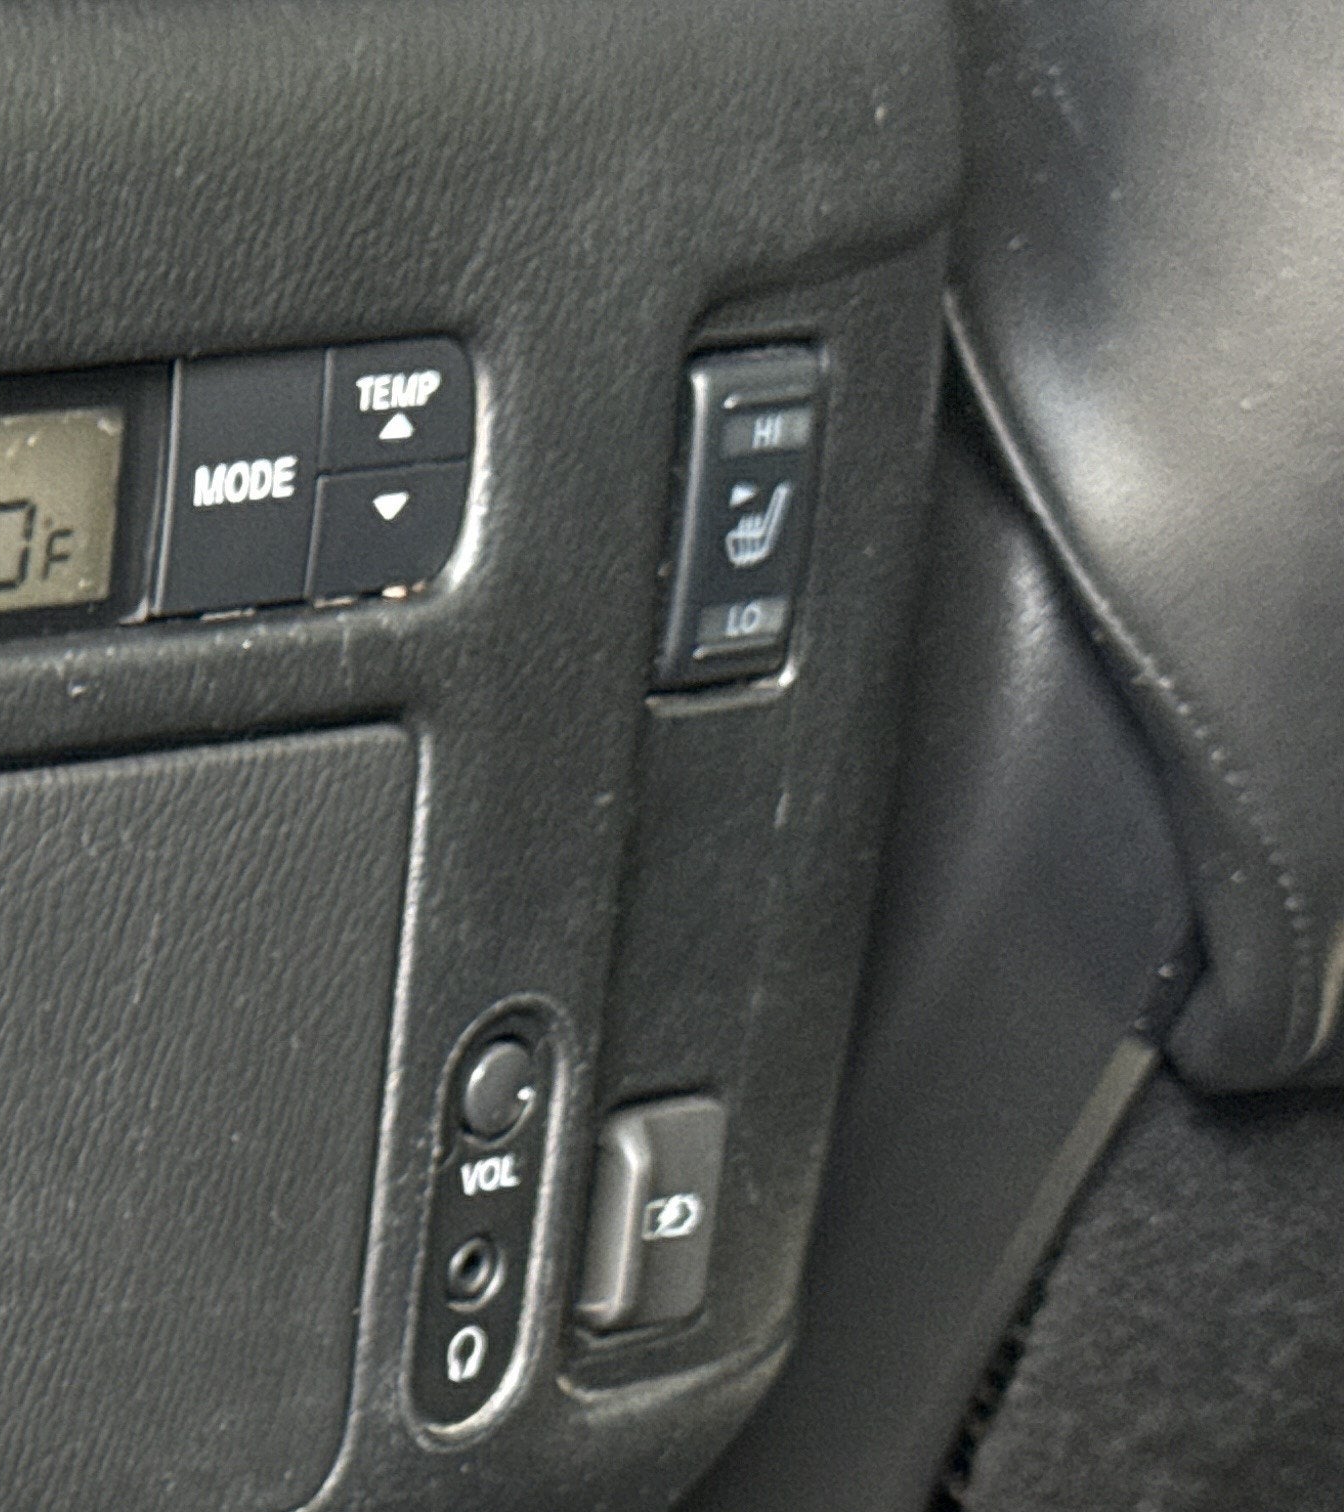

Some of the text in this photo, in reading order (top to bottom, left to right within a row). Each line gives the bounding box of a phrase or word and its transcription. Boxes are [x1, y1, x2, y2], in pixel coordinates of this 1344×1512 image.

[356, 370, 440, 411] TEMP
[752, 413, 782, 449] HI
[193, 455, 297, 506] MODE
[725, 603, 762, 637] LO
[460, 1155, 519, 1195] VOL
